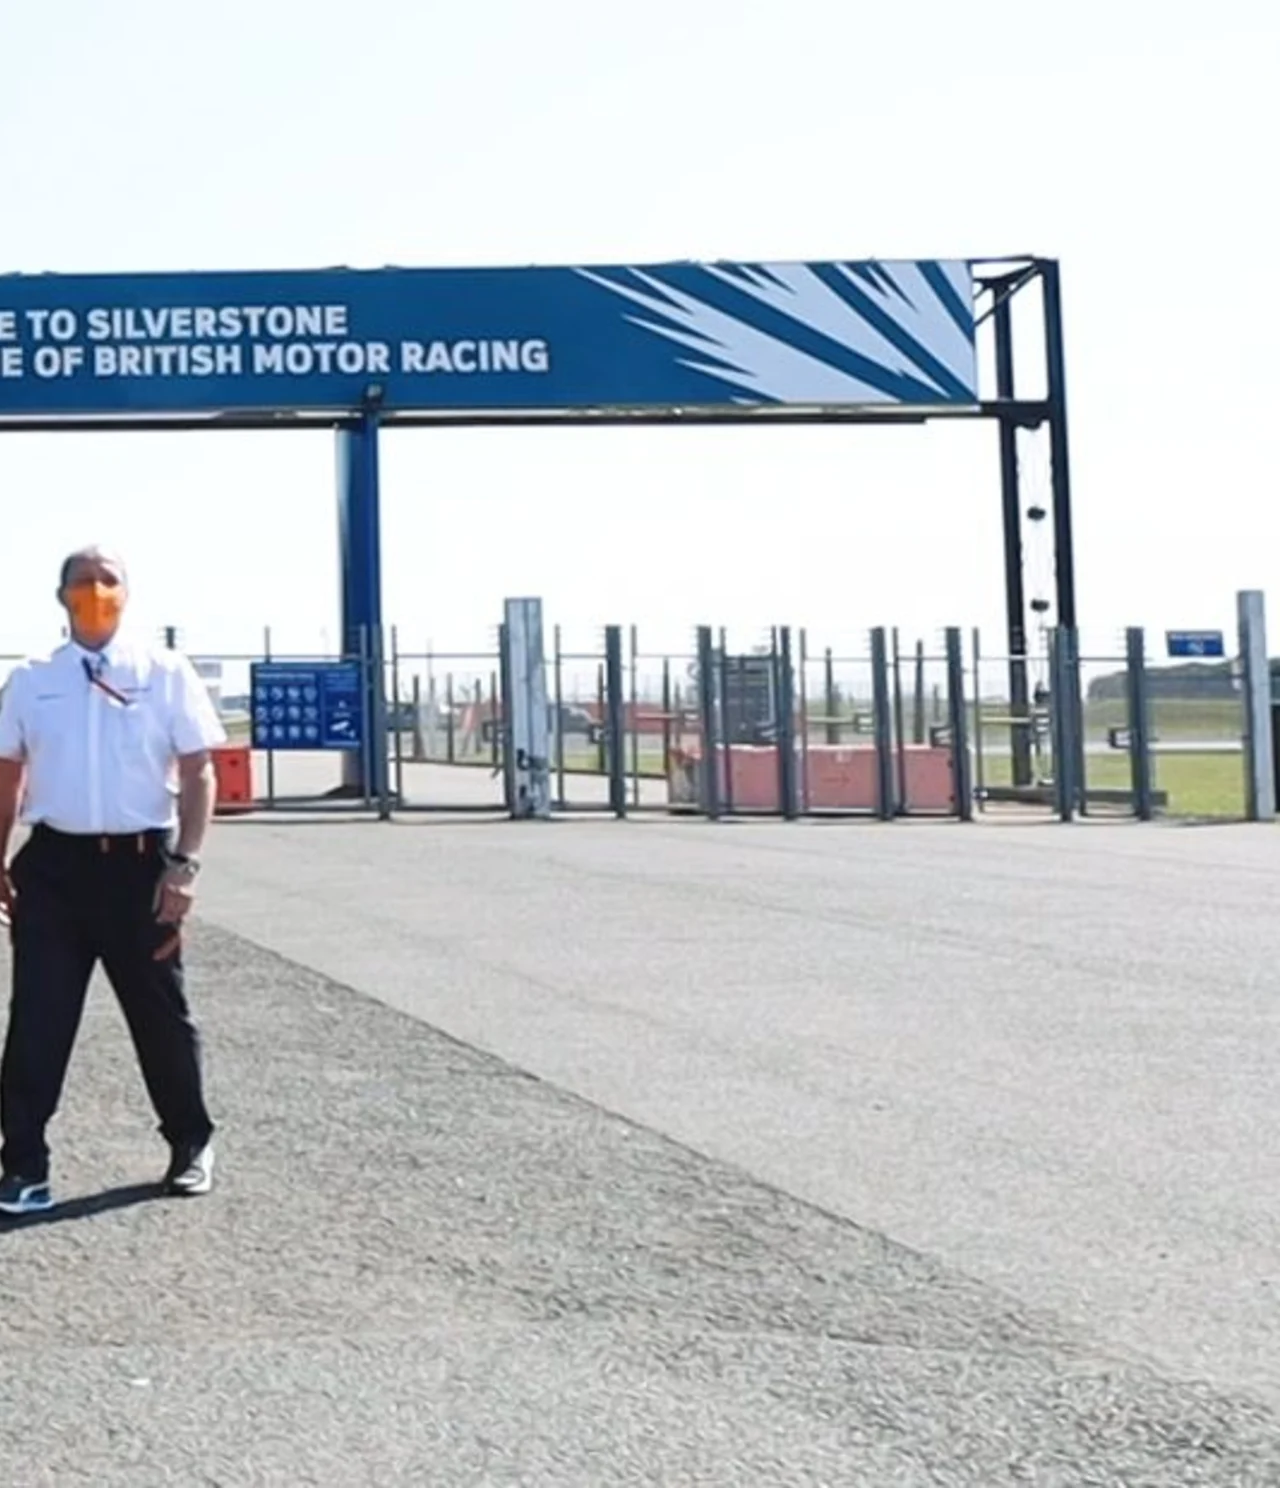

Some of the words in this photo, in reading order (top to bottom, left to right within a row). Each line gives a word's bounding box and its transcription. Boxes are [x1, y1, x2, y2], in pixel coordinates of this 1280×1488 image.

[25, 309, 77, 340] TO
[86, 305, 348, 340] SILVERSTONE
[33, 346, 85, 377] OF
[94, 344, 242, 377] BRITISH
[252, 342, 391, 375] MOTOR
[400, 340, 550, 372] RACING
